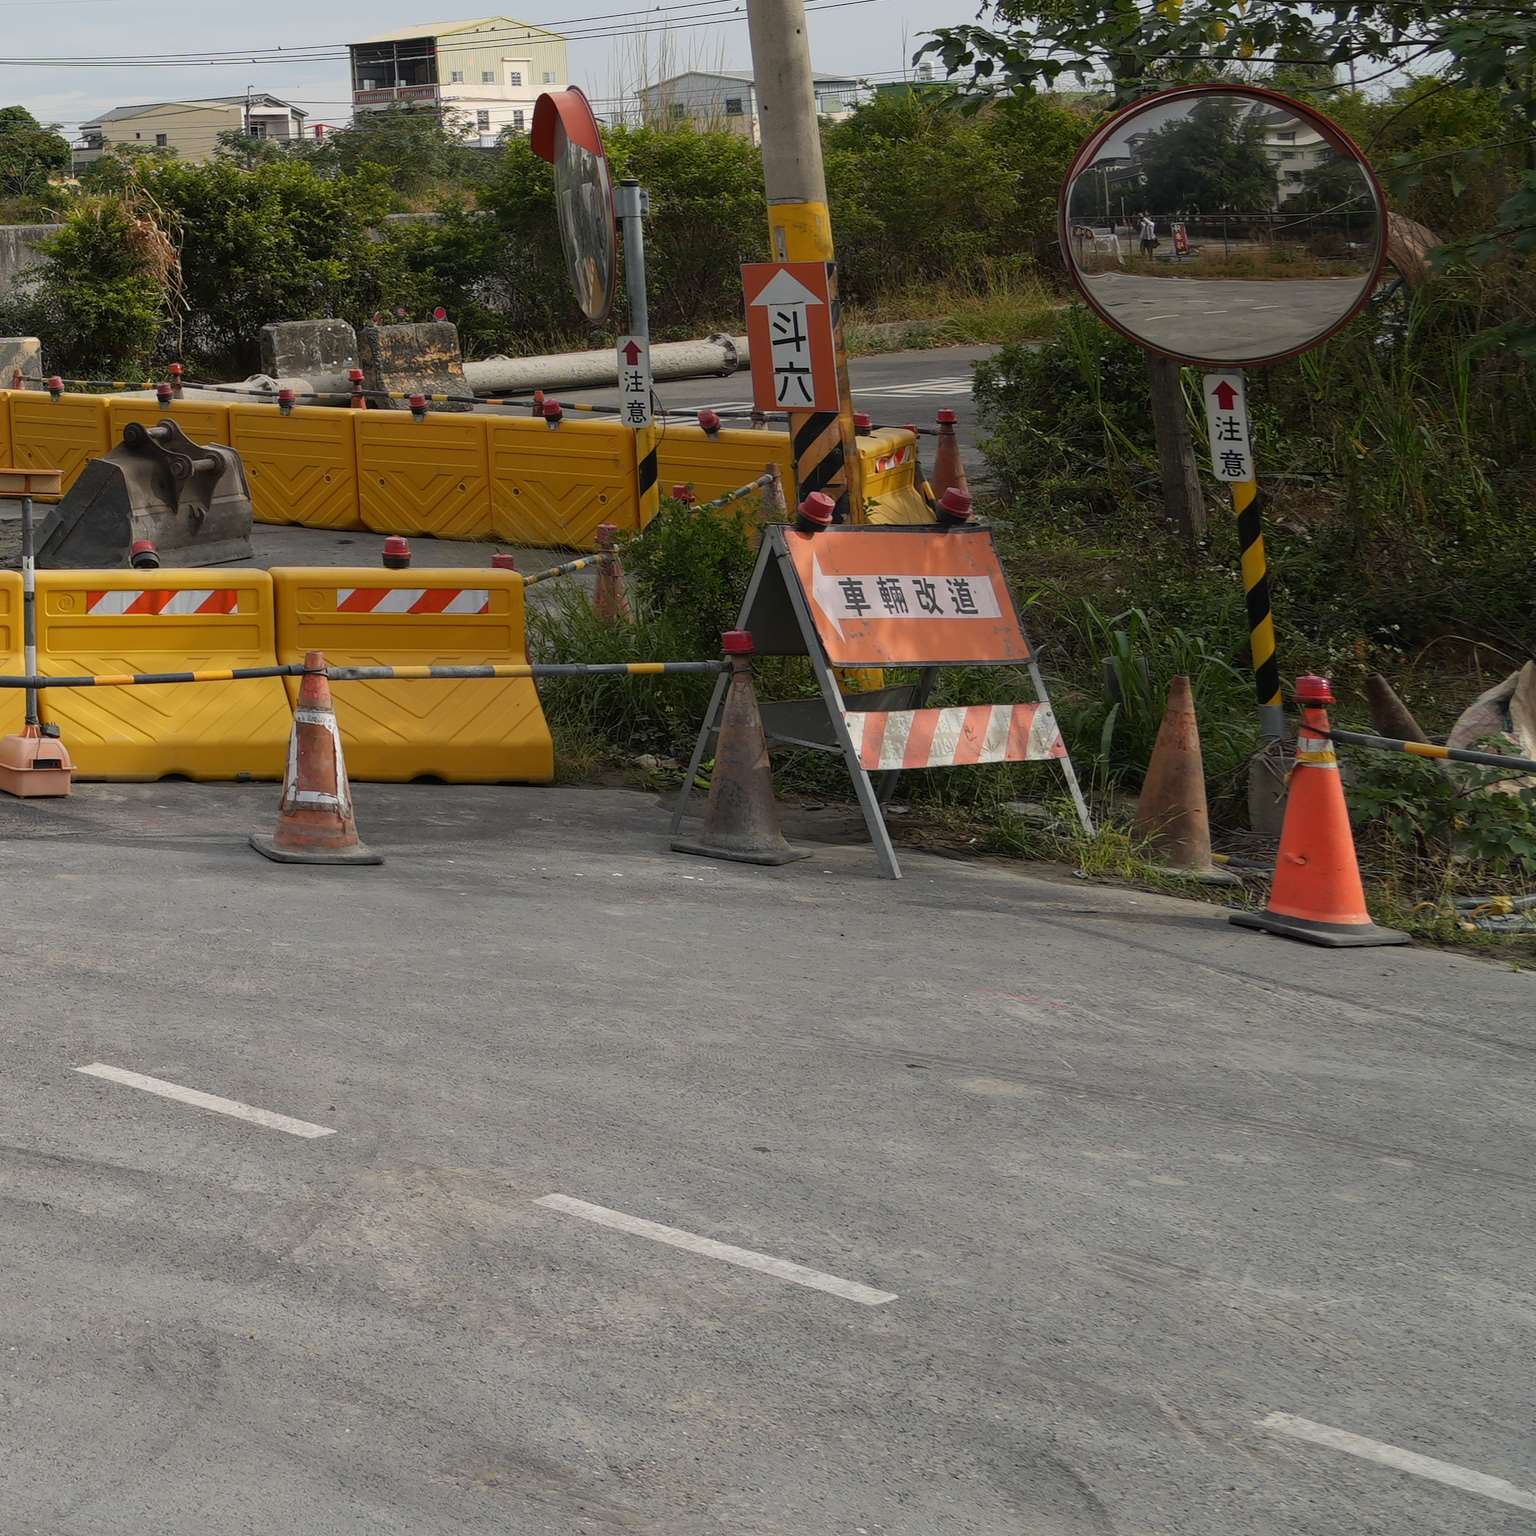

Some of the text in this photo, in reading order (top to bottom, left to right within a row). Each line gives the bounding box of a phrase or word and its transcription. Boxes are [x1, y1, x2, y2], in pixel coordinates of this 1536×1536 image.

[773, 311, 812, 402] 斗六
[624, 370, 647, 423] 注意
[1216, 416, 1246, 477] 注意
[838, 576, 978, 617] 車輛改道
